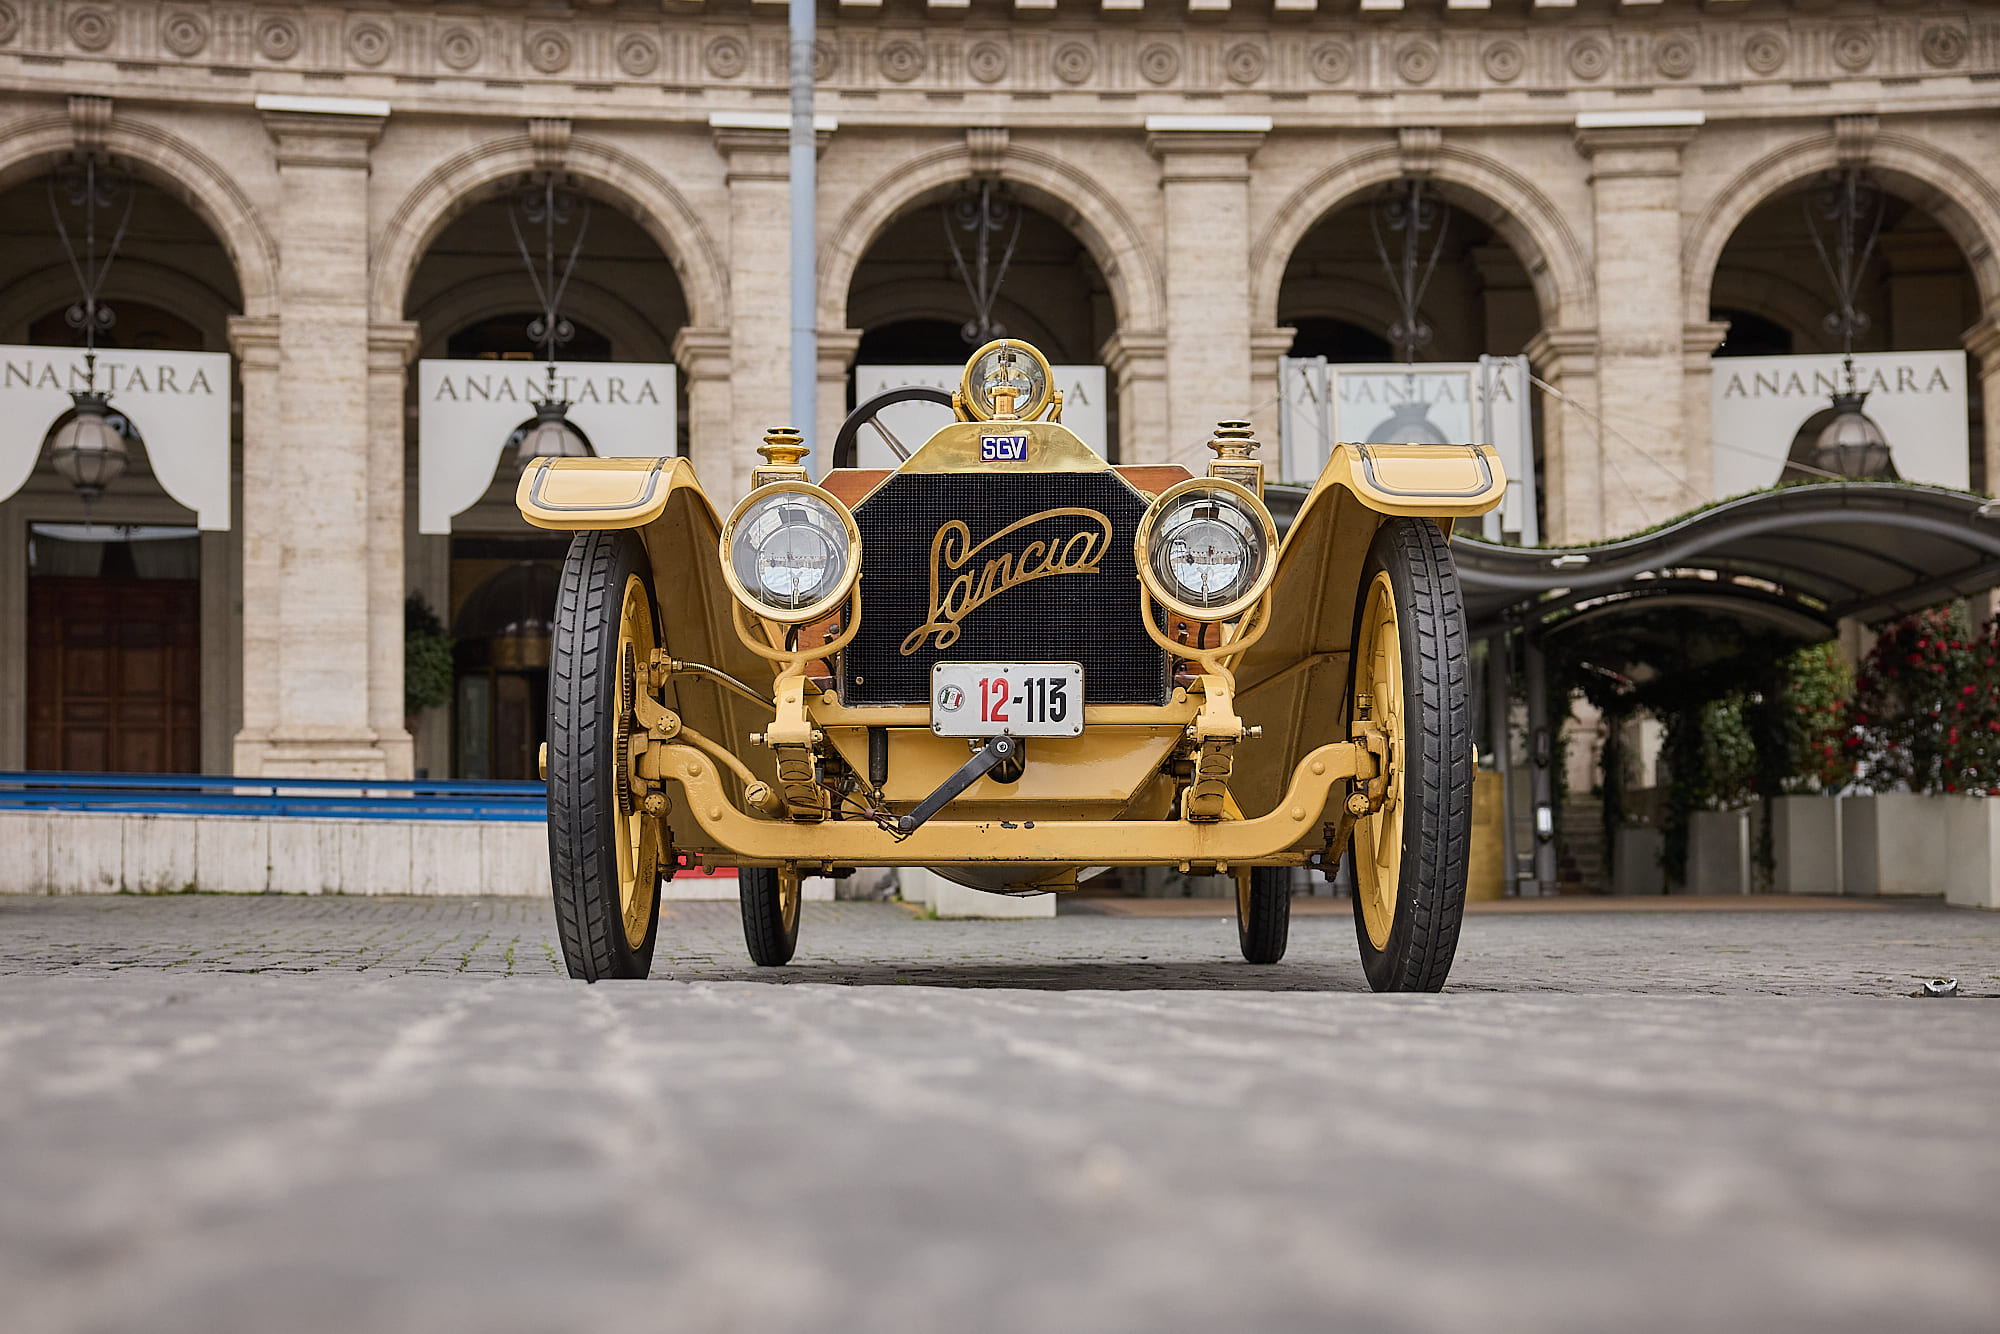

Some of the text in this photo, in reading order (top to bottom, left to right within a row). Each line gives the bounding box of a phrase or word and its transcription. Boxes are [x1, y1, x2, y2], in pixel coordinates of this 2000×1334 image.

[434, 374, 660, 405] ANANTARA
[1724, 364, 1950, 398] ANANTARA
[982, 437, 1025, 459] SGV
[900, 507, 1113, 656] Lancia
[978, 677, 1067, 722] 12-113
